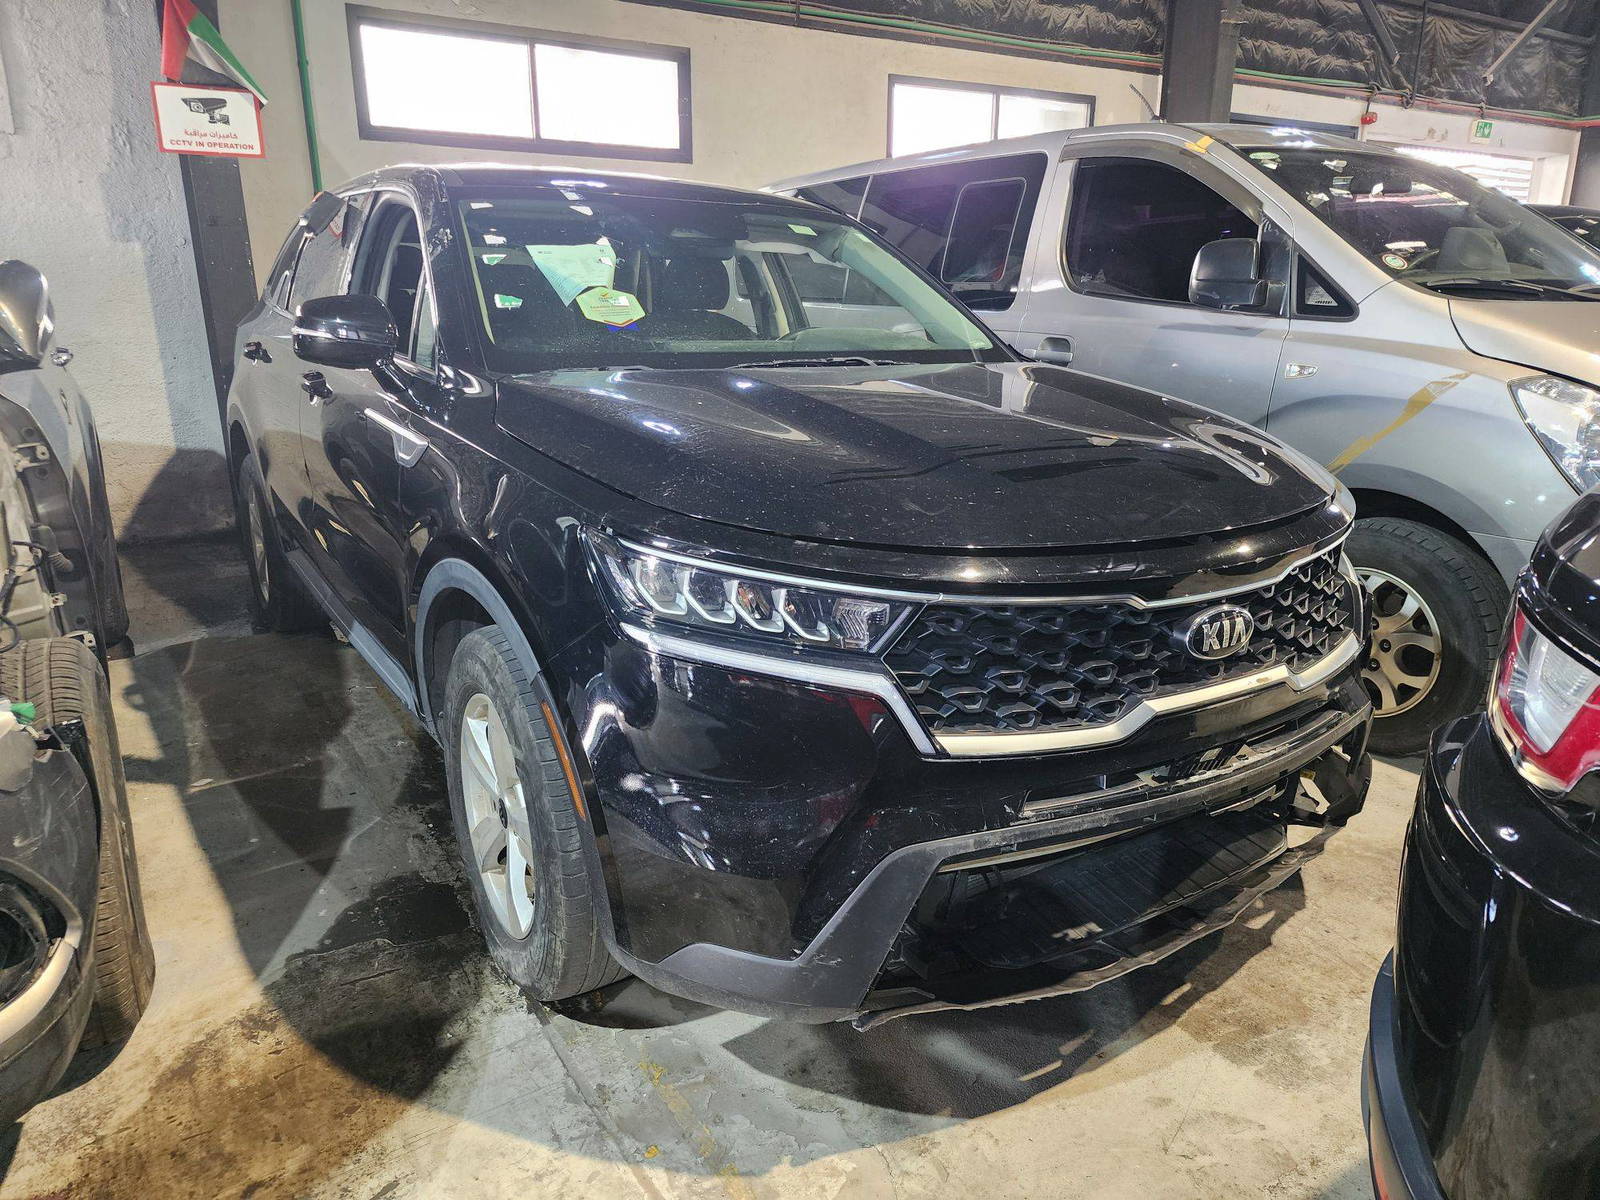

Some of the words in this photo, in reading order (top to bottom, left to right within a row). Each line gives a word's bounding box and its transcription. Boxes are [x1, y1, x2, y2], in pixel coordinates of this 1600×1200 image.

[184, 128, 208, 138] مراقبة
[209, 130, 238, 139] كاميرات
[207, 141, 255, 150] OPERATION
[1201, 616, 1246, 652] KIA
